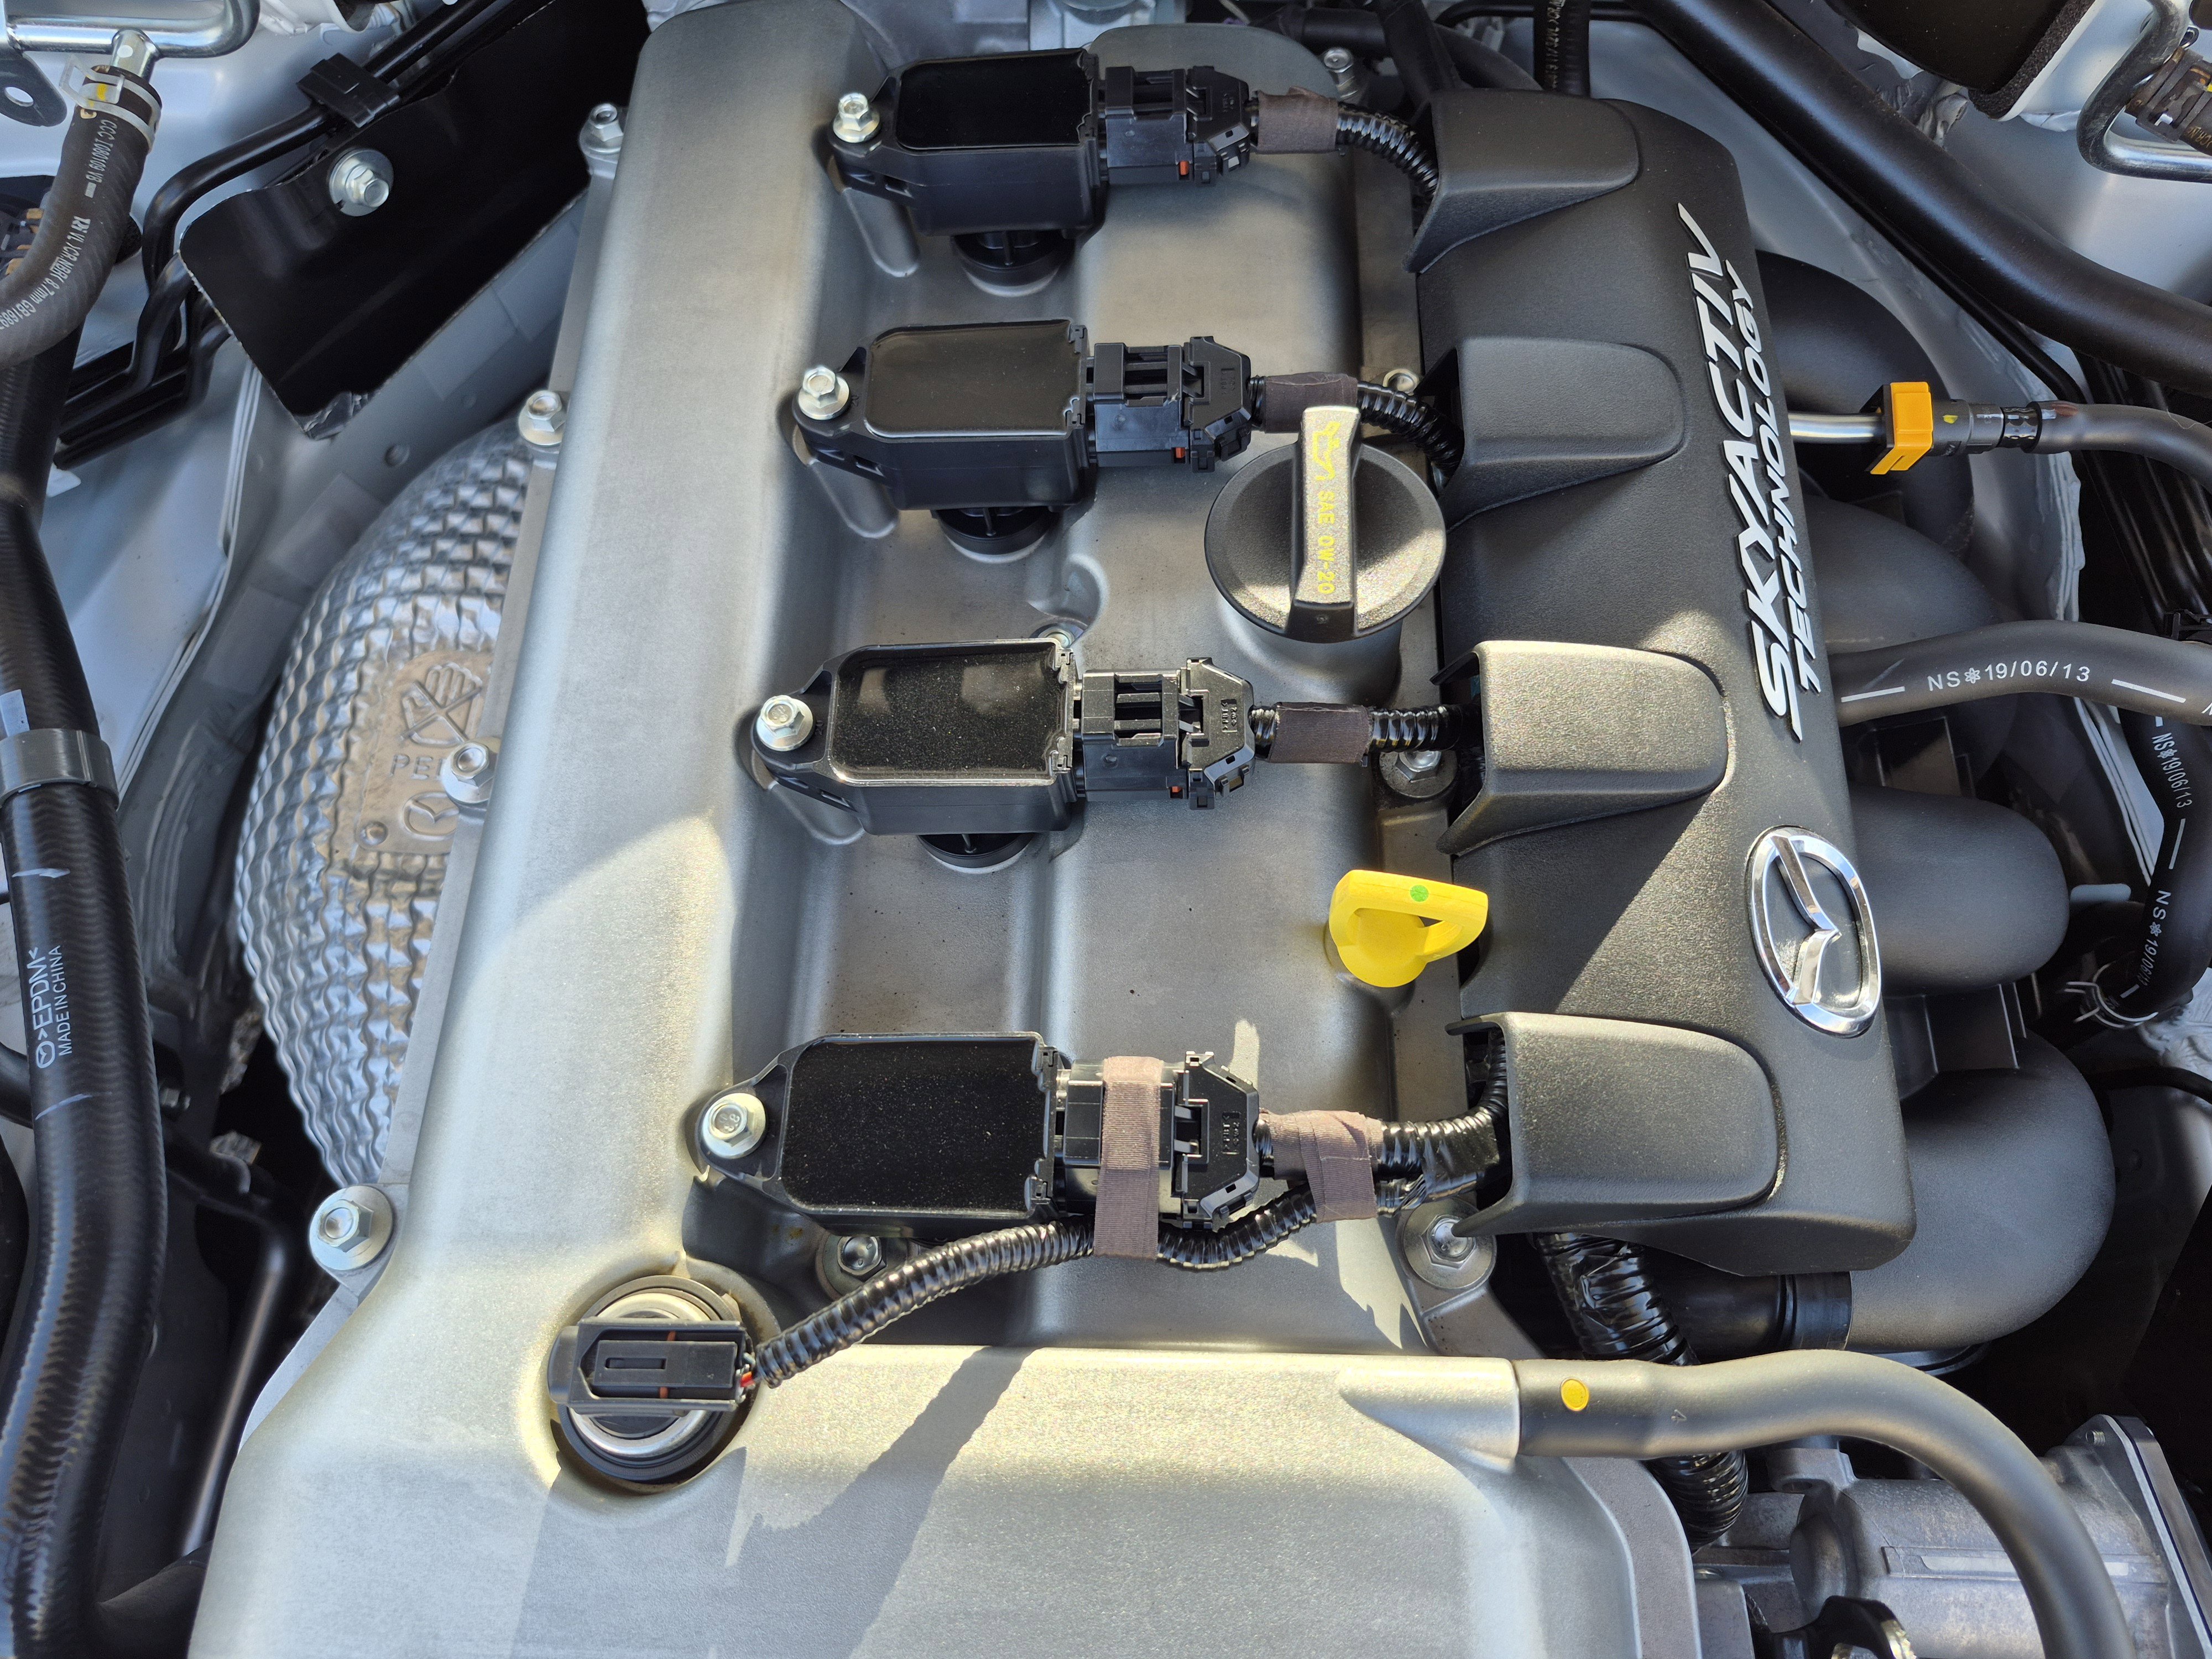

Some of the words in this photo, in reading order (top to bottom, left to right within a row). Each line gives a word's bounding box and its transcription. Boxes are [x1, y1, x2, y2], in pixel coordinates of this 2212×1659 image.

[98, 119, 118, 140] CCC
[1677, 202, 1803, 742] SKYACTIV
[1725, 259, 1822, 693] TECHNOLOGY
[1318, 491, 1335, 525] SAE
[48, 945, 67, 993] CHINA
[54, 995, 69, 1011] IN
[56, 1011, 72, 1056] MADE
